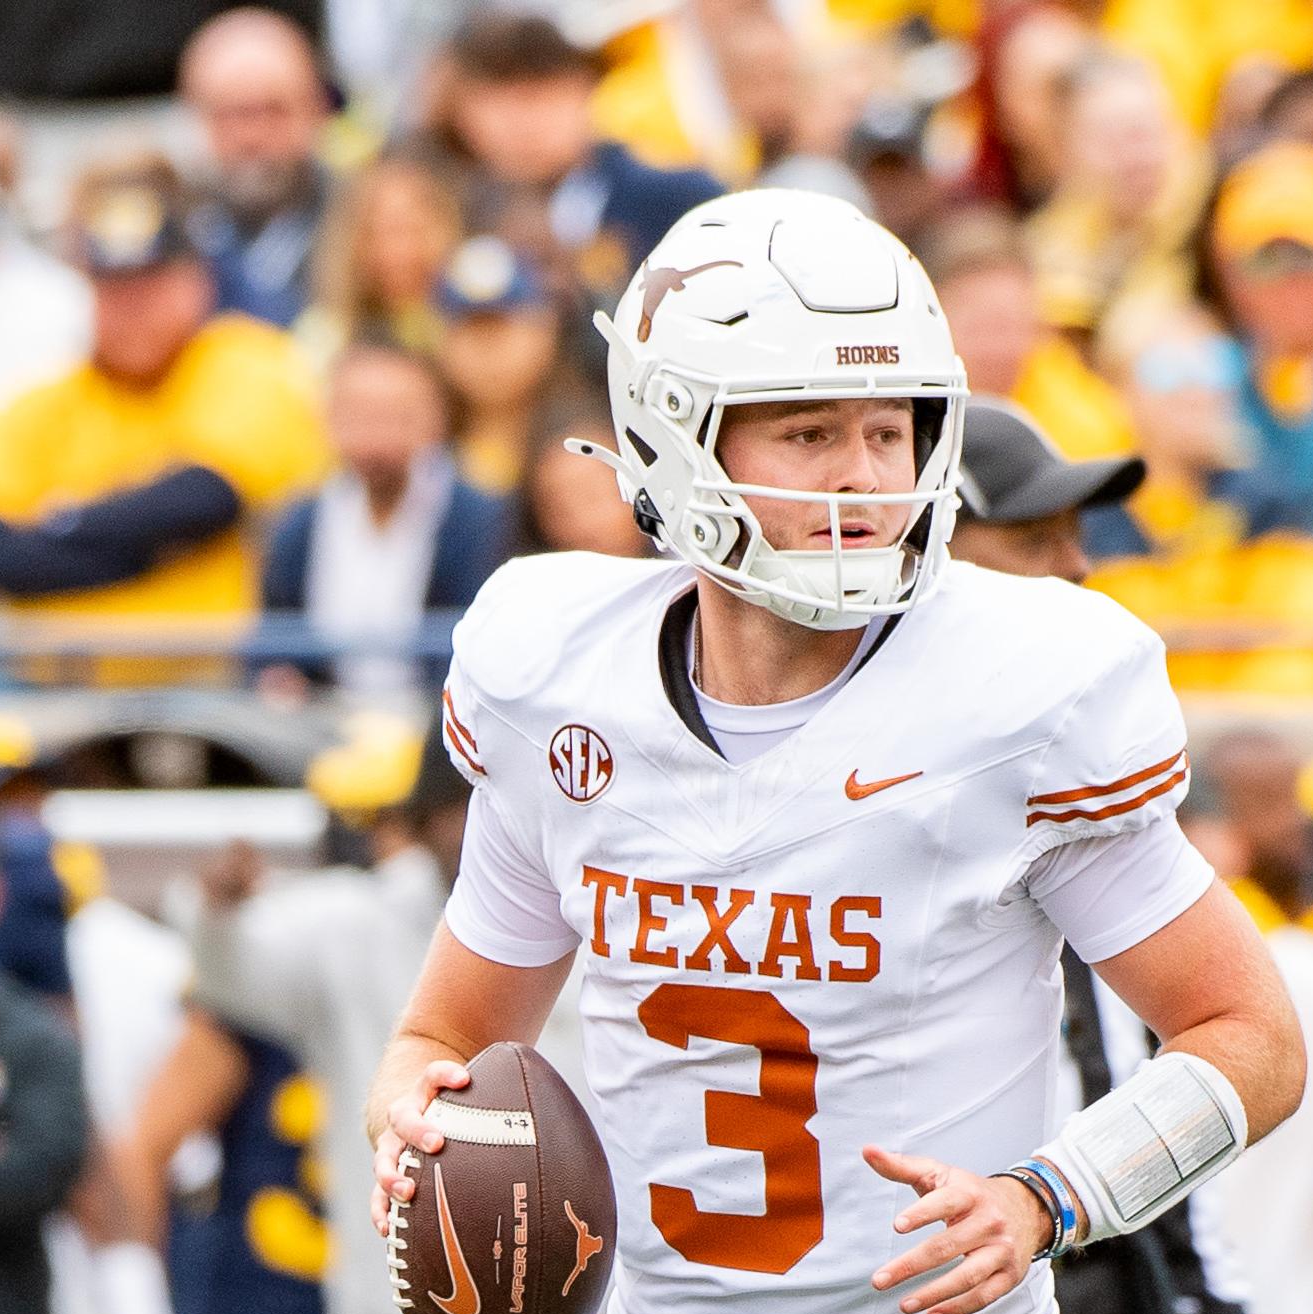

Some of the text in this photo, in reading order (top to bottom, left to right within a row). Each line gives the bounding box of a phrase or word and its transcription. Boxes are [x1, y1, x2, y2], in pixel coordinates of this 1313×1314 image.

[836, 345, 900, 365] HORNS
[552, 725, 614, 800] SEC
[582, 864, 882, 983] TEXAS
[637, 983, 824, 1275] 3
[509, 1182, 528, 1313] VAPOR ELITE
